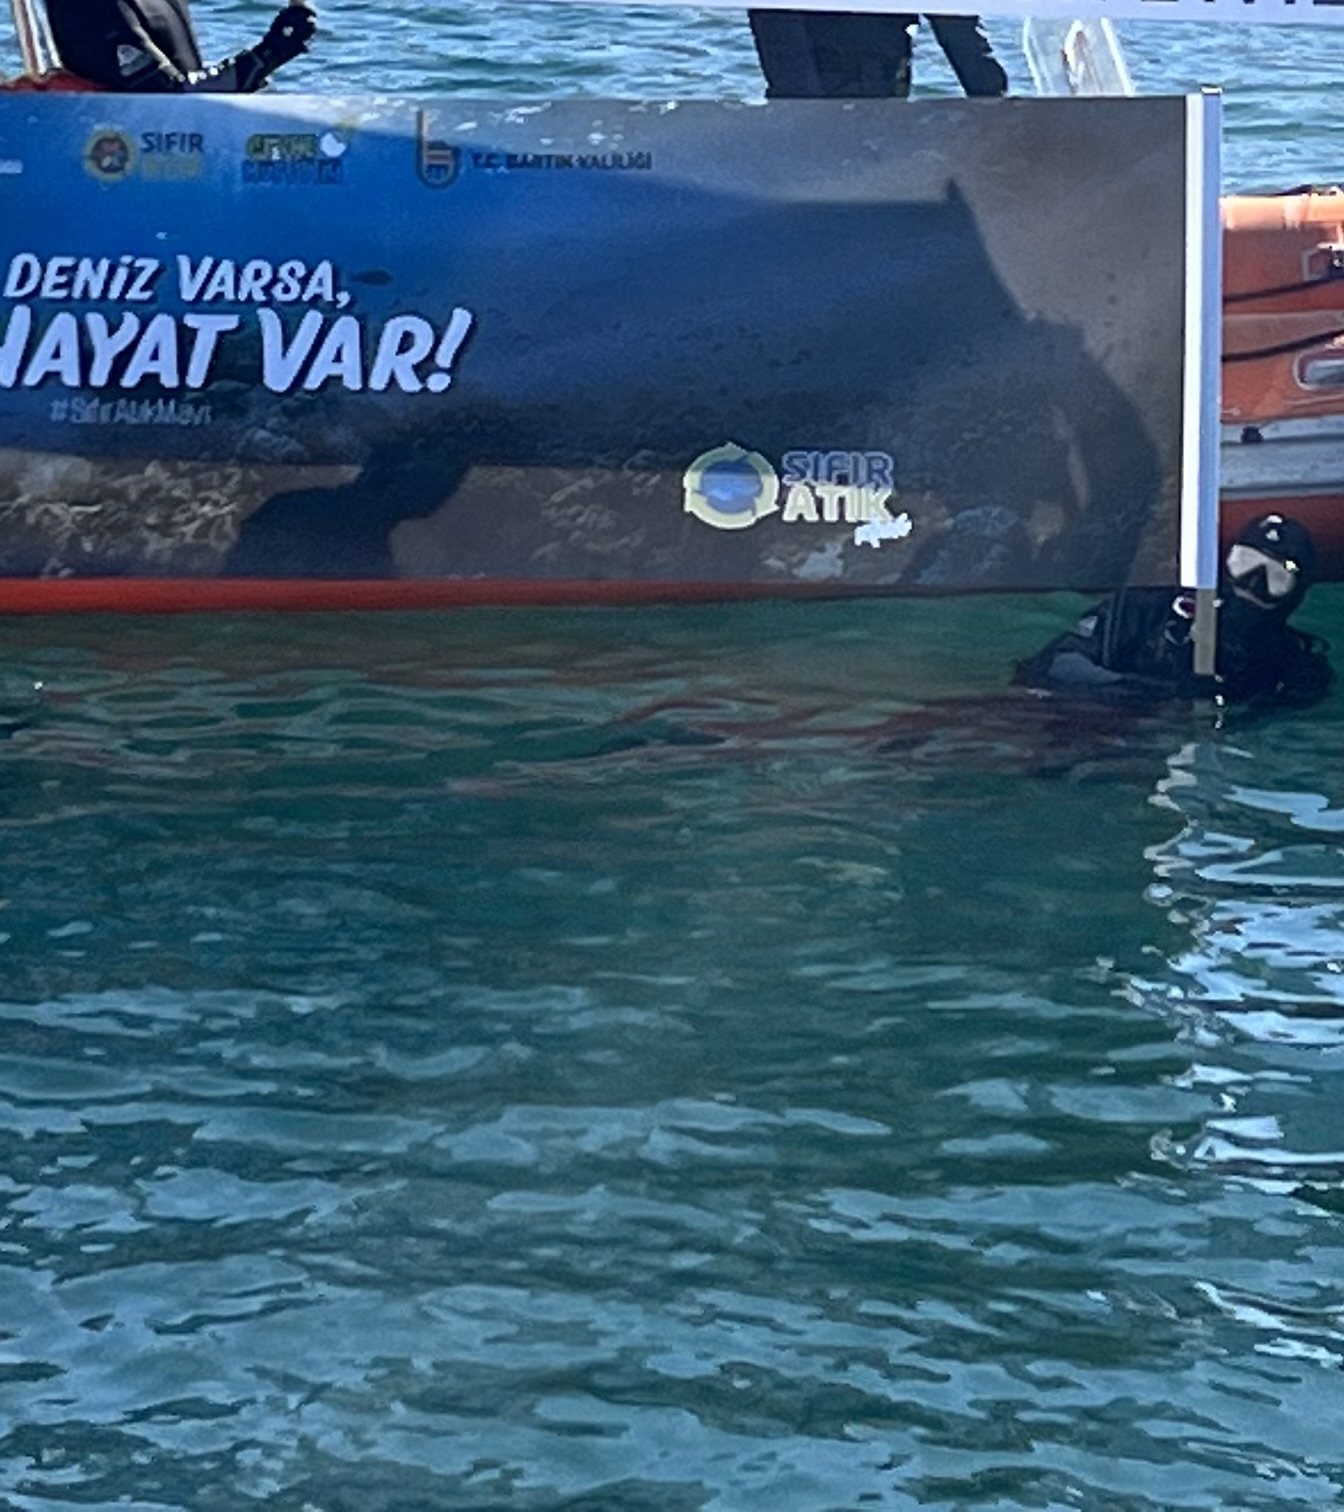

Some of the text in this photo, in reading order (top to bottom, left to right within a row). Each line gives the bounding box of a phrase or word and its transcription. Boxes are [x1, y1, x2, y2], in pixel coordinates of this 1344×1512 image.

[140, 131, 205, 153] SIFIR
[3, 252, 353, 309] DENİZ VARSA,
[256, 307, 474, 393] VAR!
[782, 451, 894, 486] SIFIR
[782, 485, 894, 522] ATIK
